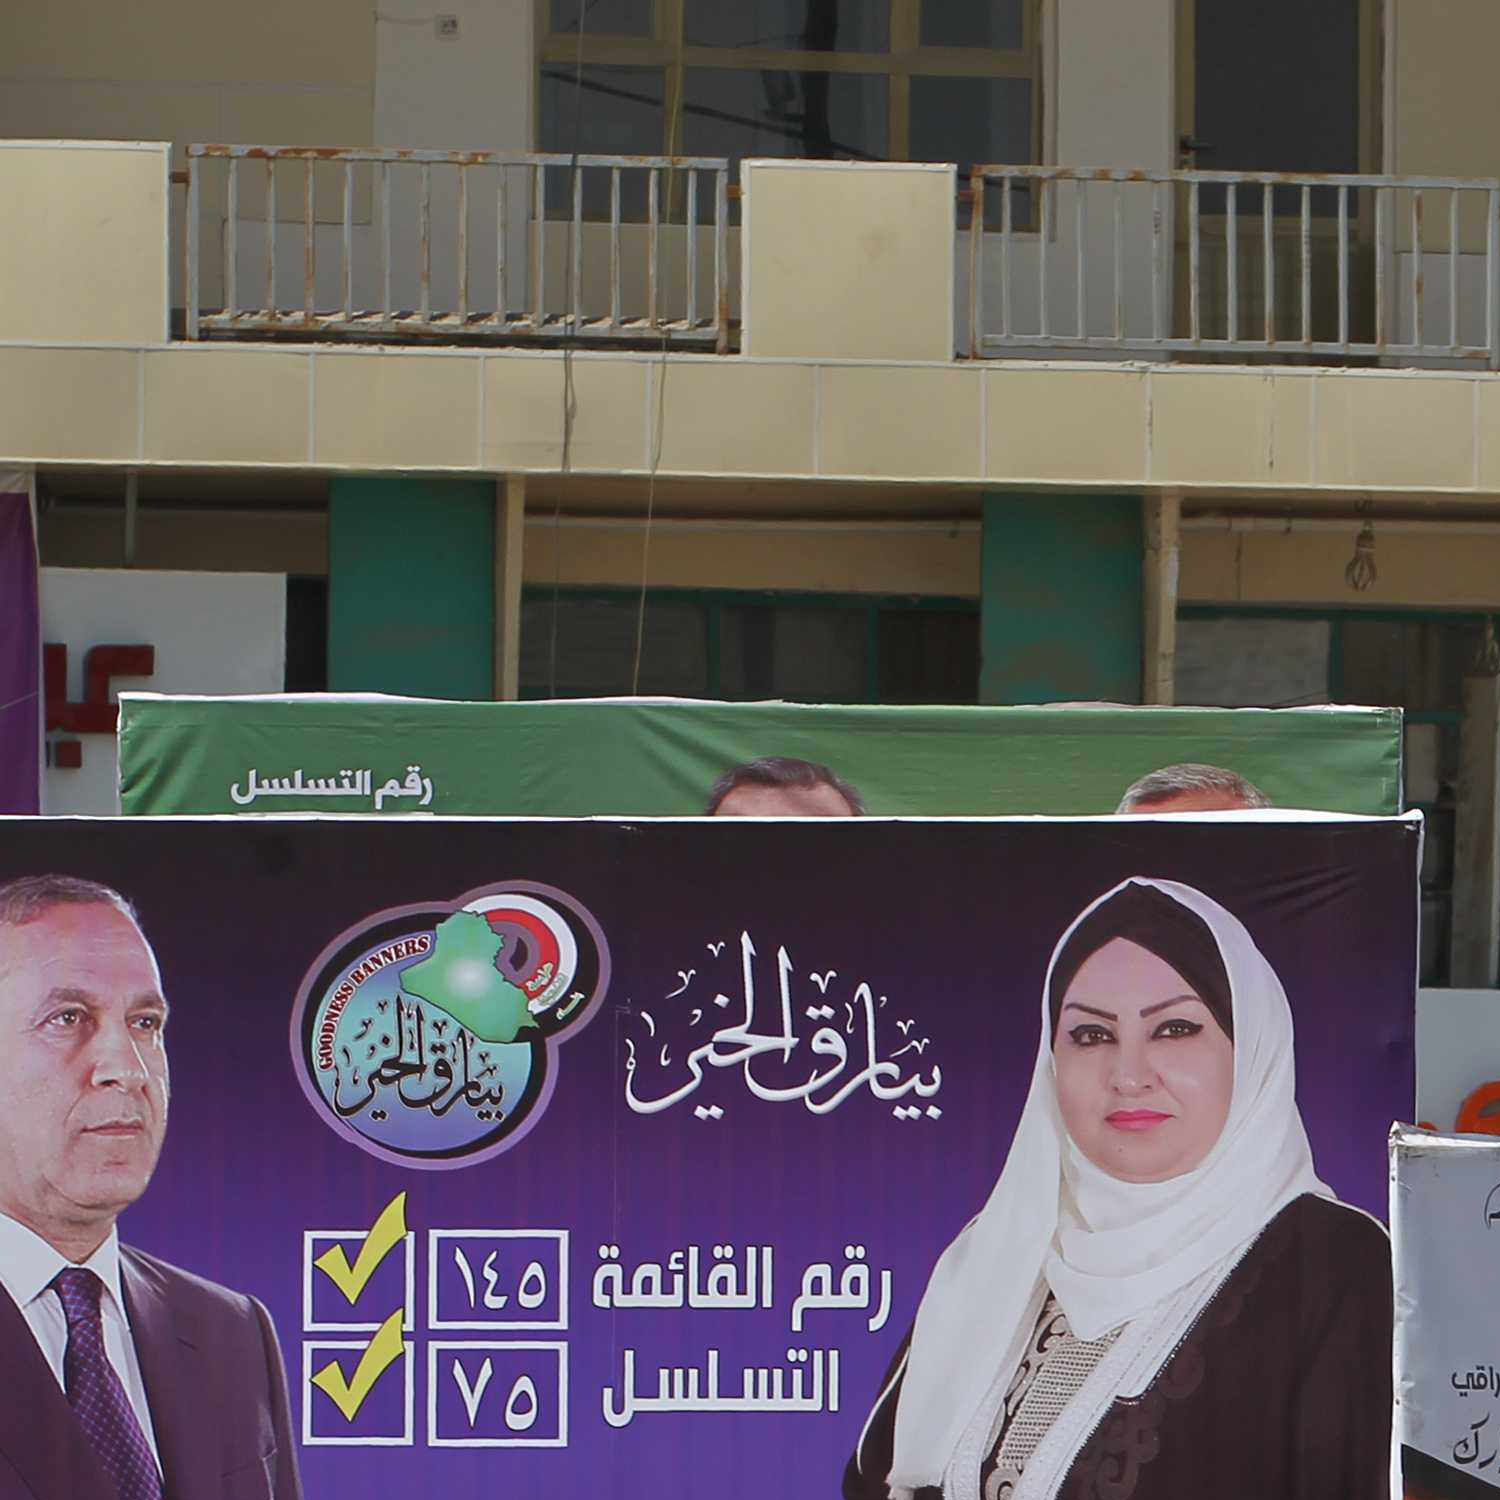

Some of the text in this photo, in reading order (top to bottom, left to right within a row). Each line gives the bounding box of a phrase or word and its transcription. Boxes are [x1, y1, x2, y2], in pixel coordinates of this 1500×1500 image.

[230, 765, 433, 810] رقم التسلسل
[318, 934, 431, 1071] GOODNESS BANNERS
[453, 1246, 547, 1310] ١٤٥
[592, 1243, 893, 1332] رقم القائمة
[451, 1357, 539, 1430] ٧٥
[601, 1347, 840, 1428] التسلسل
